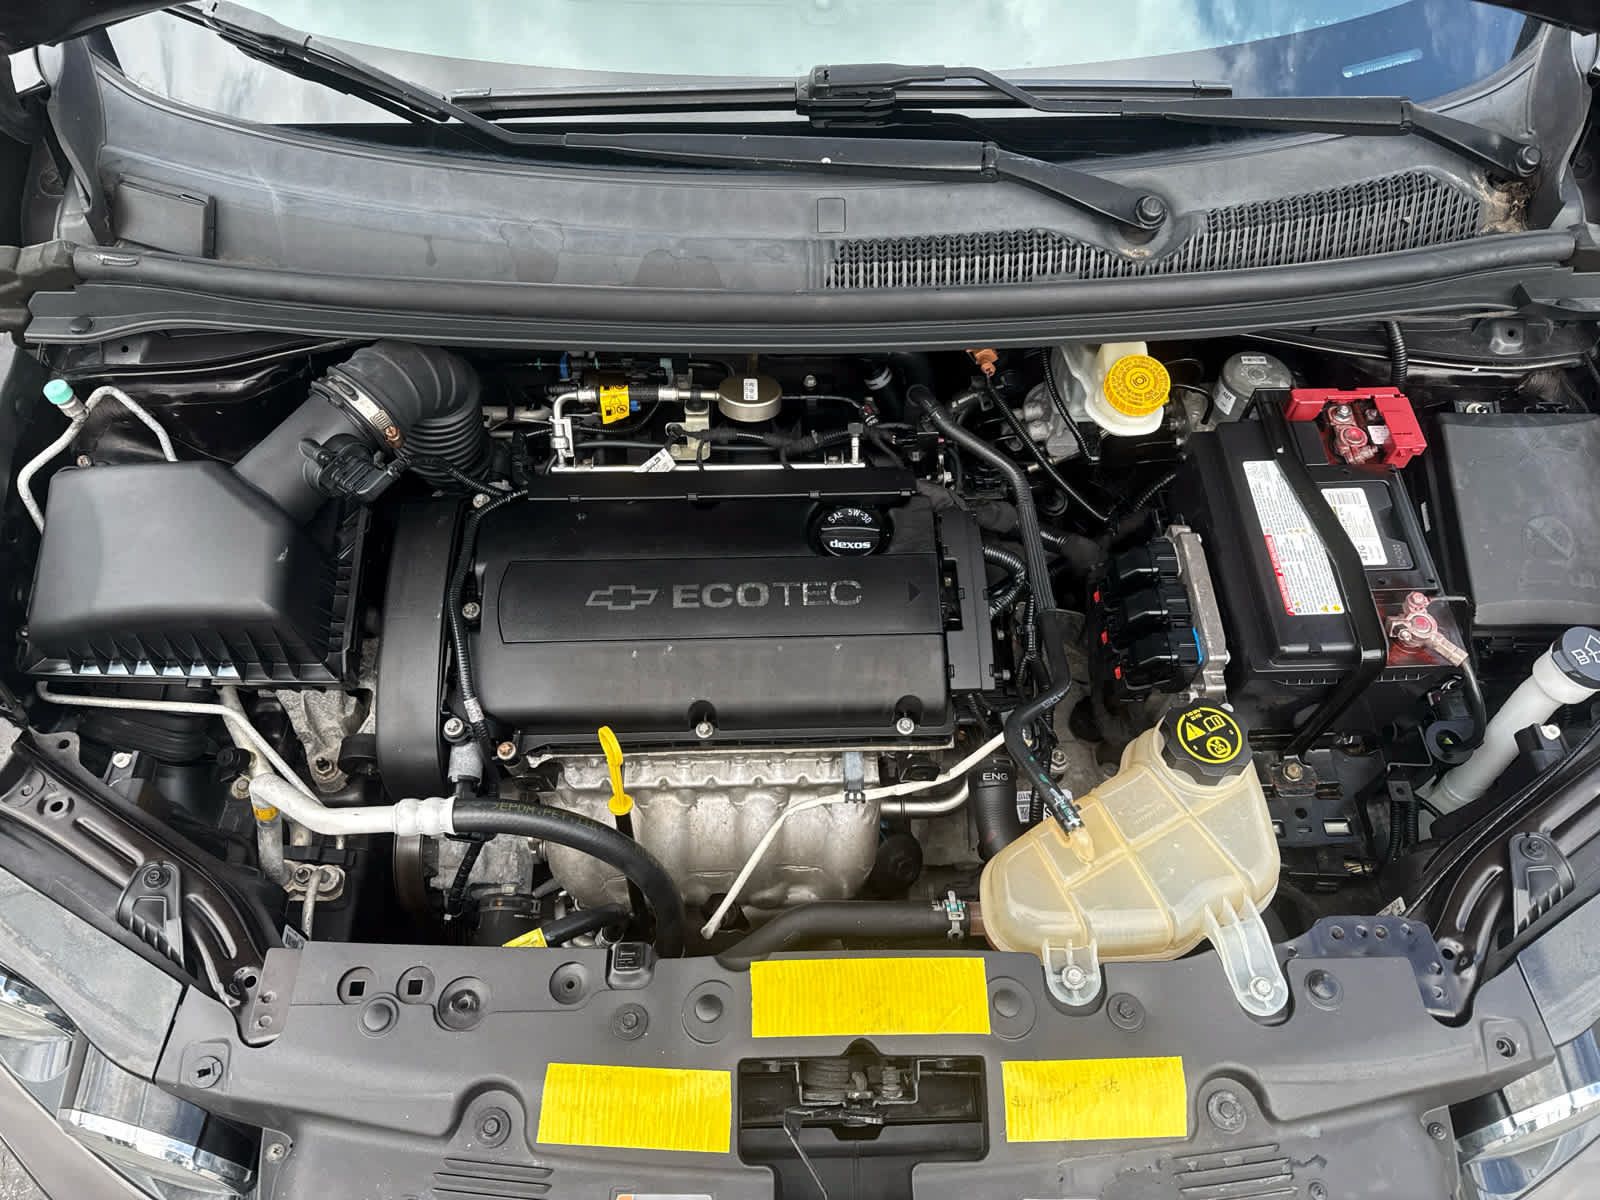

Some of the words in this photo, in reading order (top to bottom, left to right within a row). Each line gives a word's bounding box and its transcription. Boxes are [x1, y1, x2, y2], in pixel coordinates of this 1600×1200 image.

[827, 511, 844, 524] SAE
[847, 508, 872, 524] 5W-30
[829, 539, 872, 549] dexos
[672, 579, 862, 608] ECOTEC
[982, 772, 1009, 781] ENG
